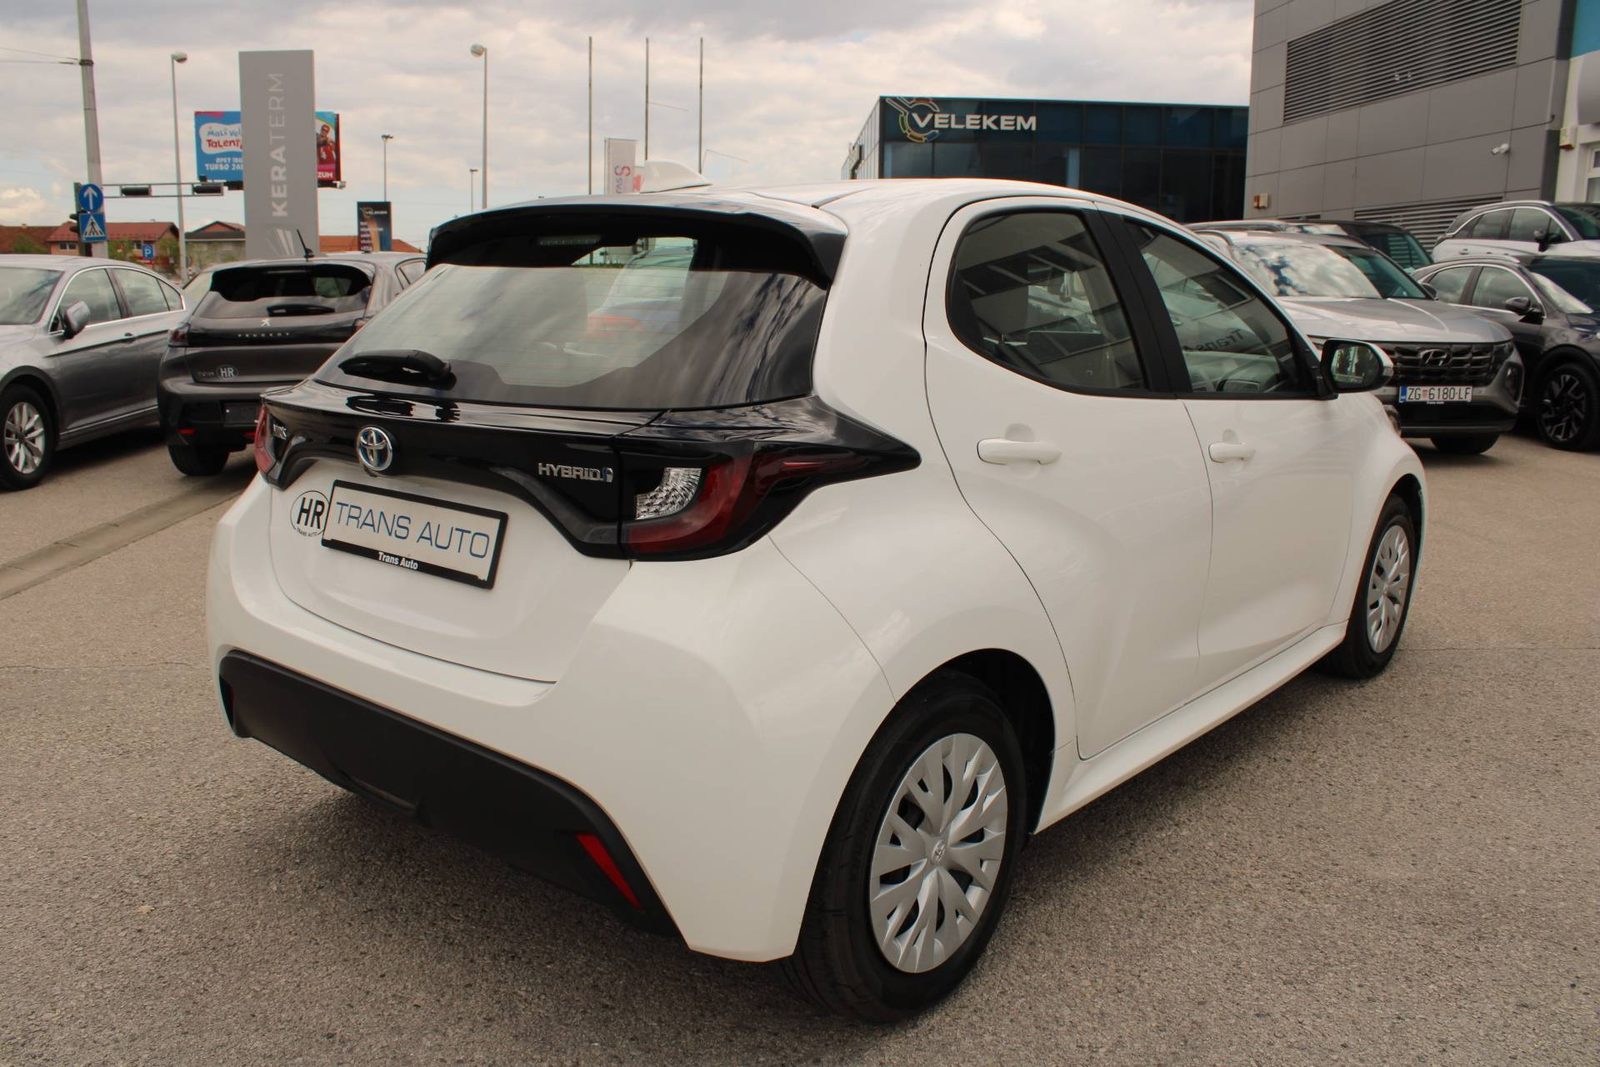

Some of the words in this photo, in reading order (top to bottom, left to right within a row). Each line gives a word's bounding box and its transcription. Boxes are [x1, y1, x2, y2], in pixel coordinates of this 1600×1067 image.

[911, 113, 1037, 131] VELEKEM
[268, 73, 289, 217] KERATERM
[220, 367, 234, 378] HR
[1408, 388, 1421, 400] ZG
[538, 462, 601, 481] HYBRID
[297, 497, 325, 530] HR
[336, 502, 411, 541] TRANS
[416, 521, 490, 559] AUTO
[378, 551, 400, 565] Trans
[400, 557, 419, 570] Auto
